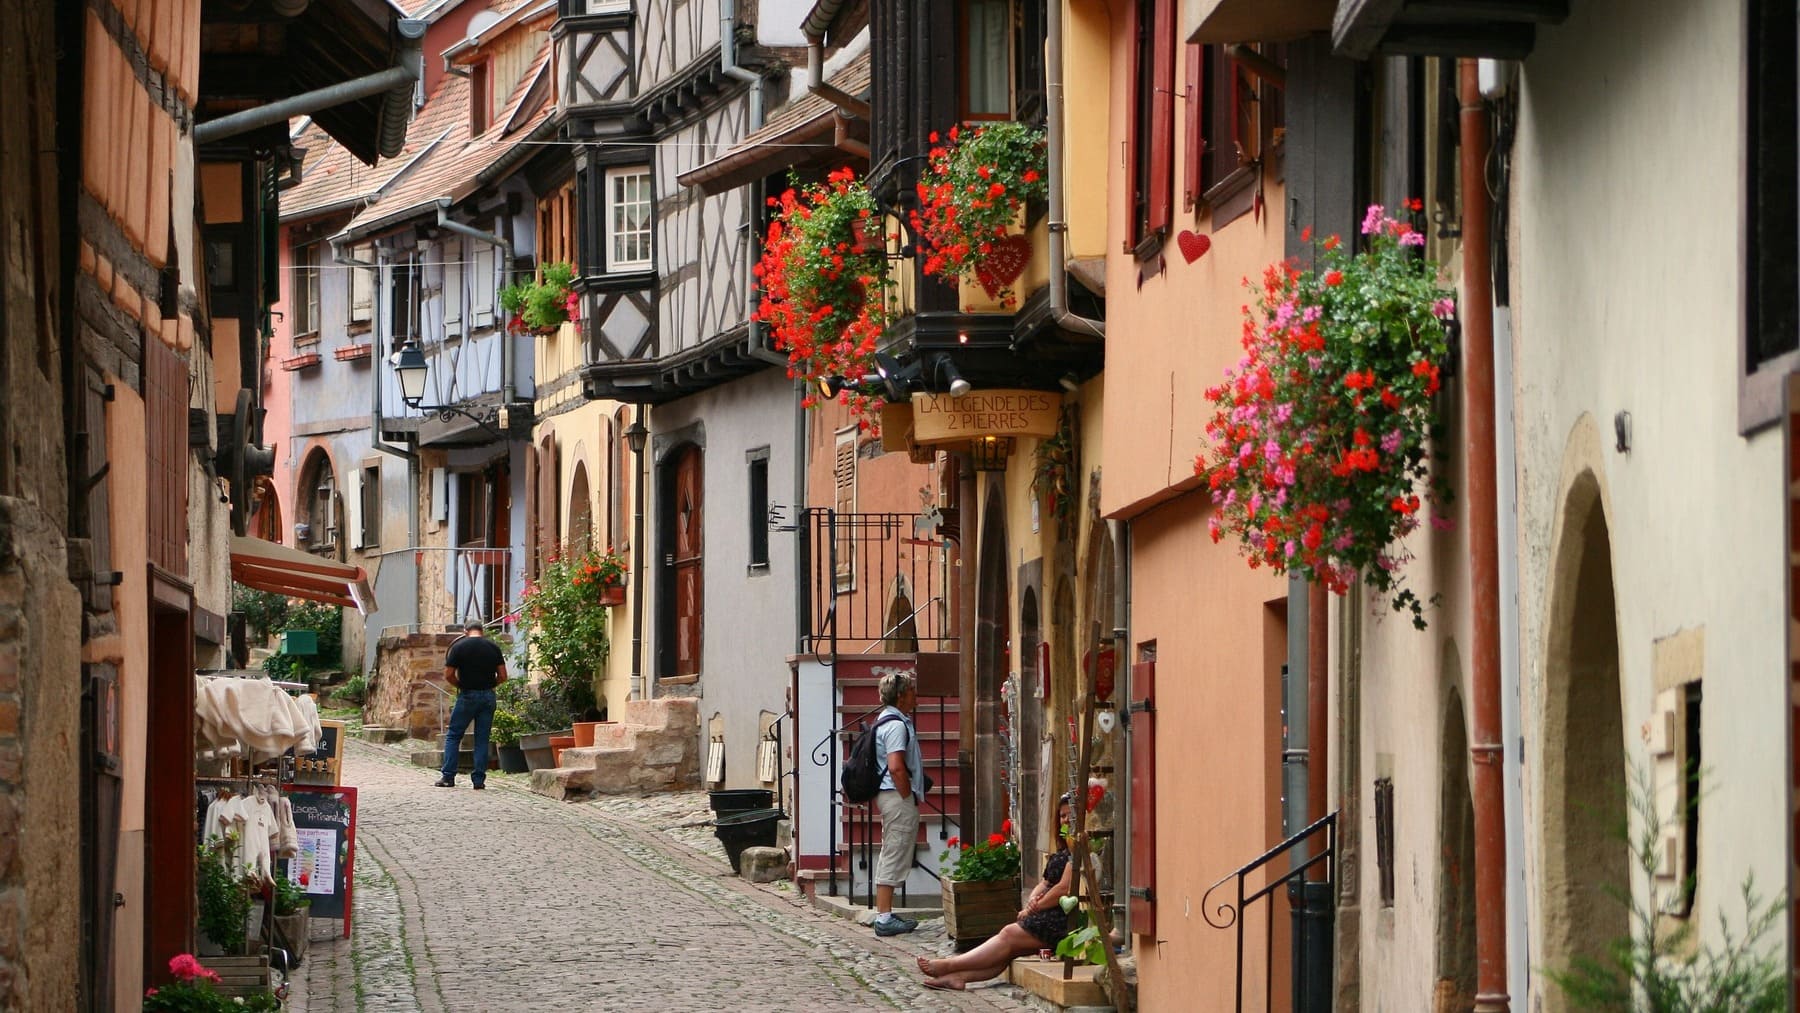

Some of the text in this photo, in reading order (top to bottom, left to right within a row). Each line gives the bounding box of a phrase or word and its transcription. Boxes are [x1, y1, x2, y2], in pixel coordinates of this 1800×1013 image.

[920, 395, 1050, 413] LA LEGENDE DES
[947, 412, 1029, 429] 2 PIERRES
